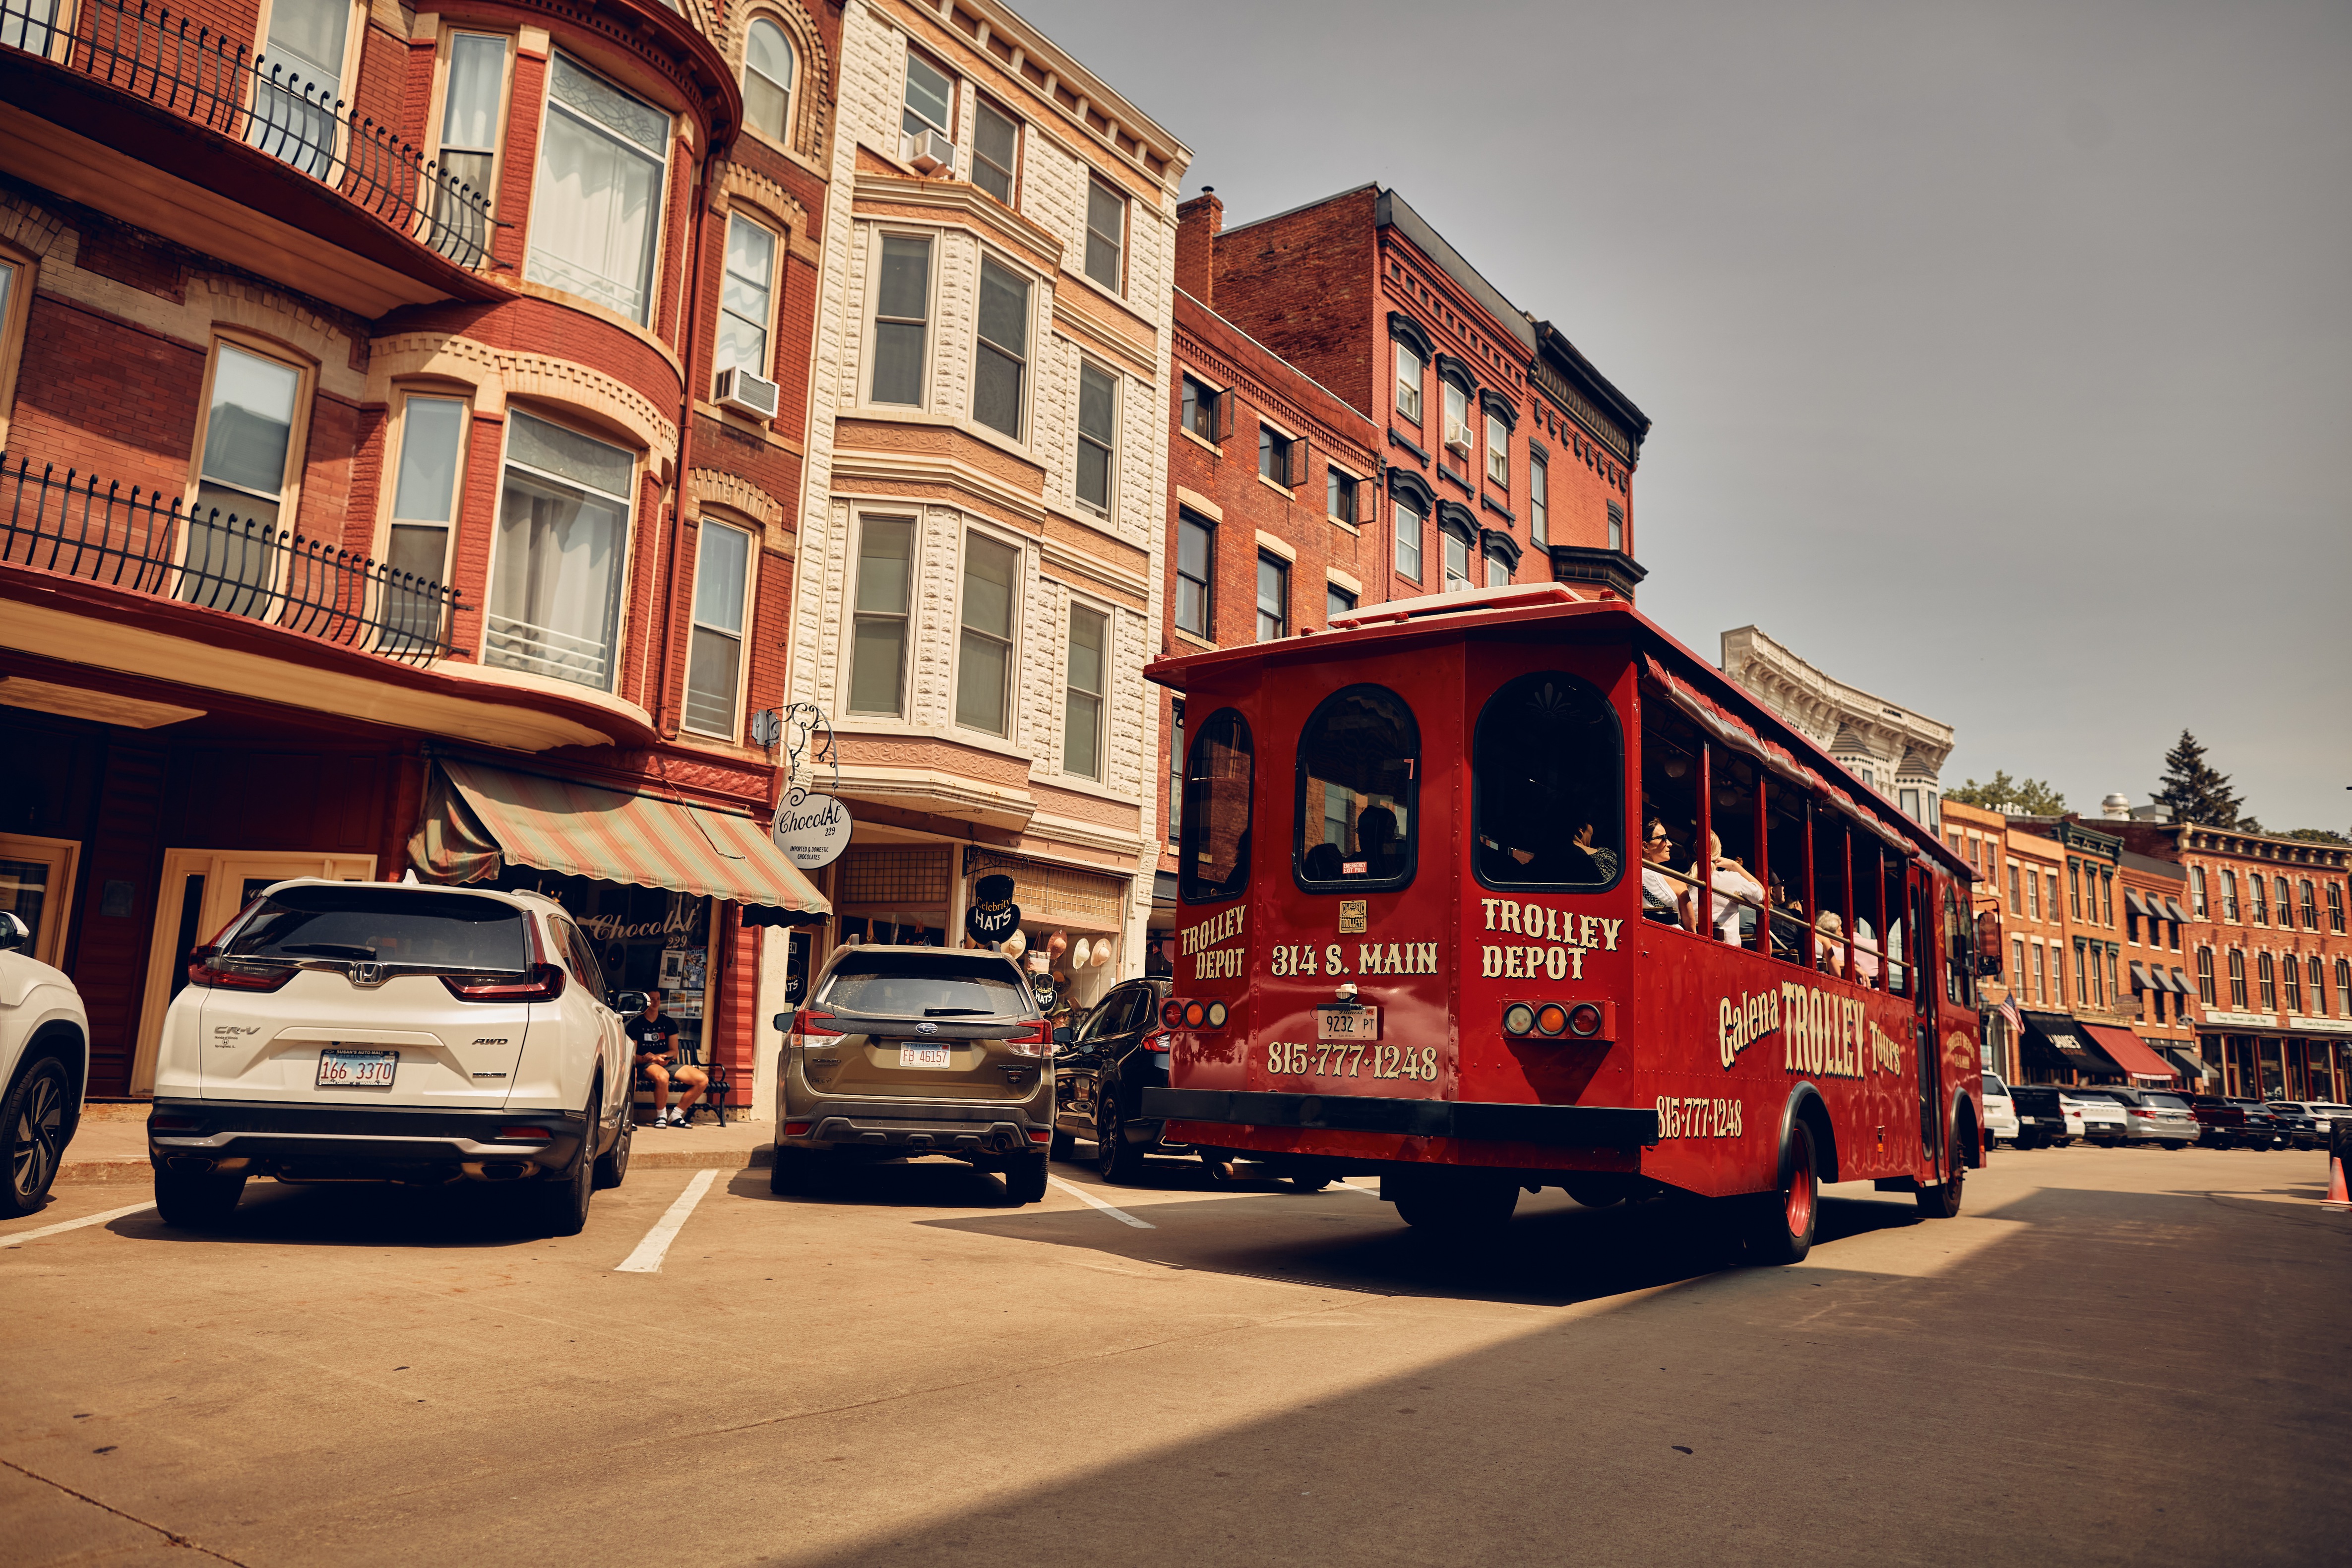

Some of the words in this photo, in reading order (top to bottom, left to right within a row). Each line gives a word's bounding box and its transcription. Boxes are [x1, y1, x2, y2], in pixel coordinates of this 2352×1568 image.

[825, 826, 835, 836] 229
[977, 897, 1011, 911] Celebrity
[1342, 903, 1364, 914] CLASSIC
[975, 907, 1011, 931] HATS
[1342, 918, 1363, 927] TROLLEYS
[1481, 898, 1623, 950] TROLLEY
[1181, 904, 1246, 956] TROLLEY
[666, 935, 687, 949] 229
[1195, 947, 1245, 980] DEPOT
[1271, 945, 1317, 976] 314
[1325, 943, 1350, 975] S.
[1358, 942, 1437, 974] MAIN
[1482, 945, 1587, 980] DEPOT
[1036, 984, 1052, 993] Celebrity
[1035, 990, 1052, 1004] HATS
[214, 1025, 261, 1035] CR-V
[1327, 1016, 1354, 1032] 9232
[1363, 1019, 1374, 1030] PT
[1719, 988, 1780, 1071] Galena
[1782, 980, 1866, 1081] TROLLEY
[1869, 1020, 1901, 1077] Tours
[903, 1050, 914, 1062] FB
[920, 1050, 947, 1063] 46157
[321, 1062, 347, 1079] 166
[356, 1063, 392, 1079] 3370
